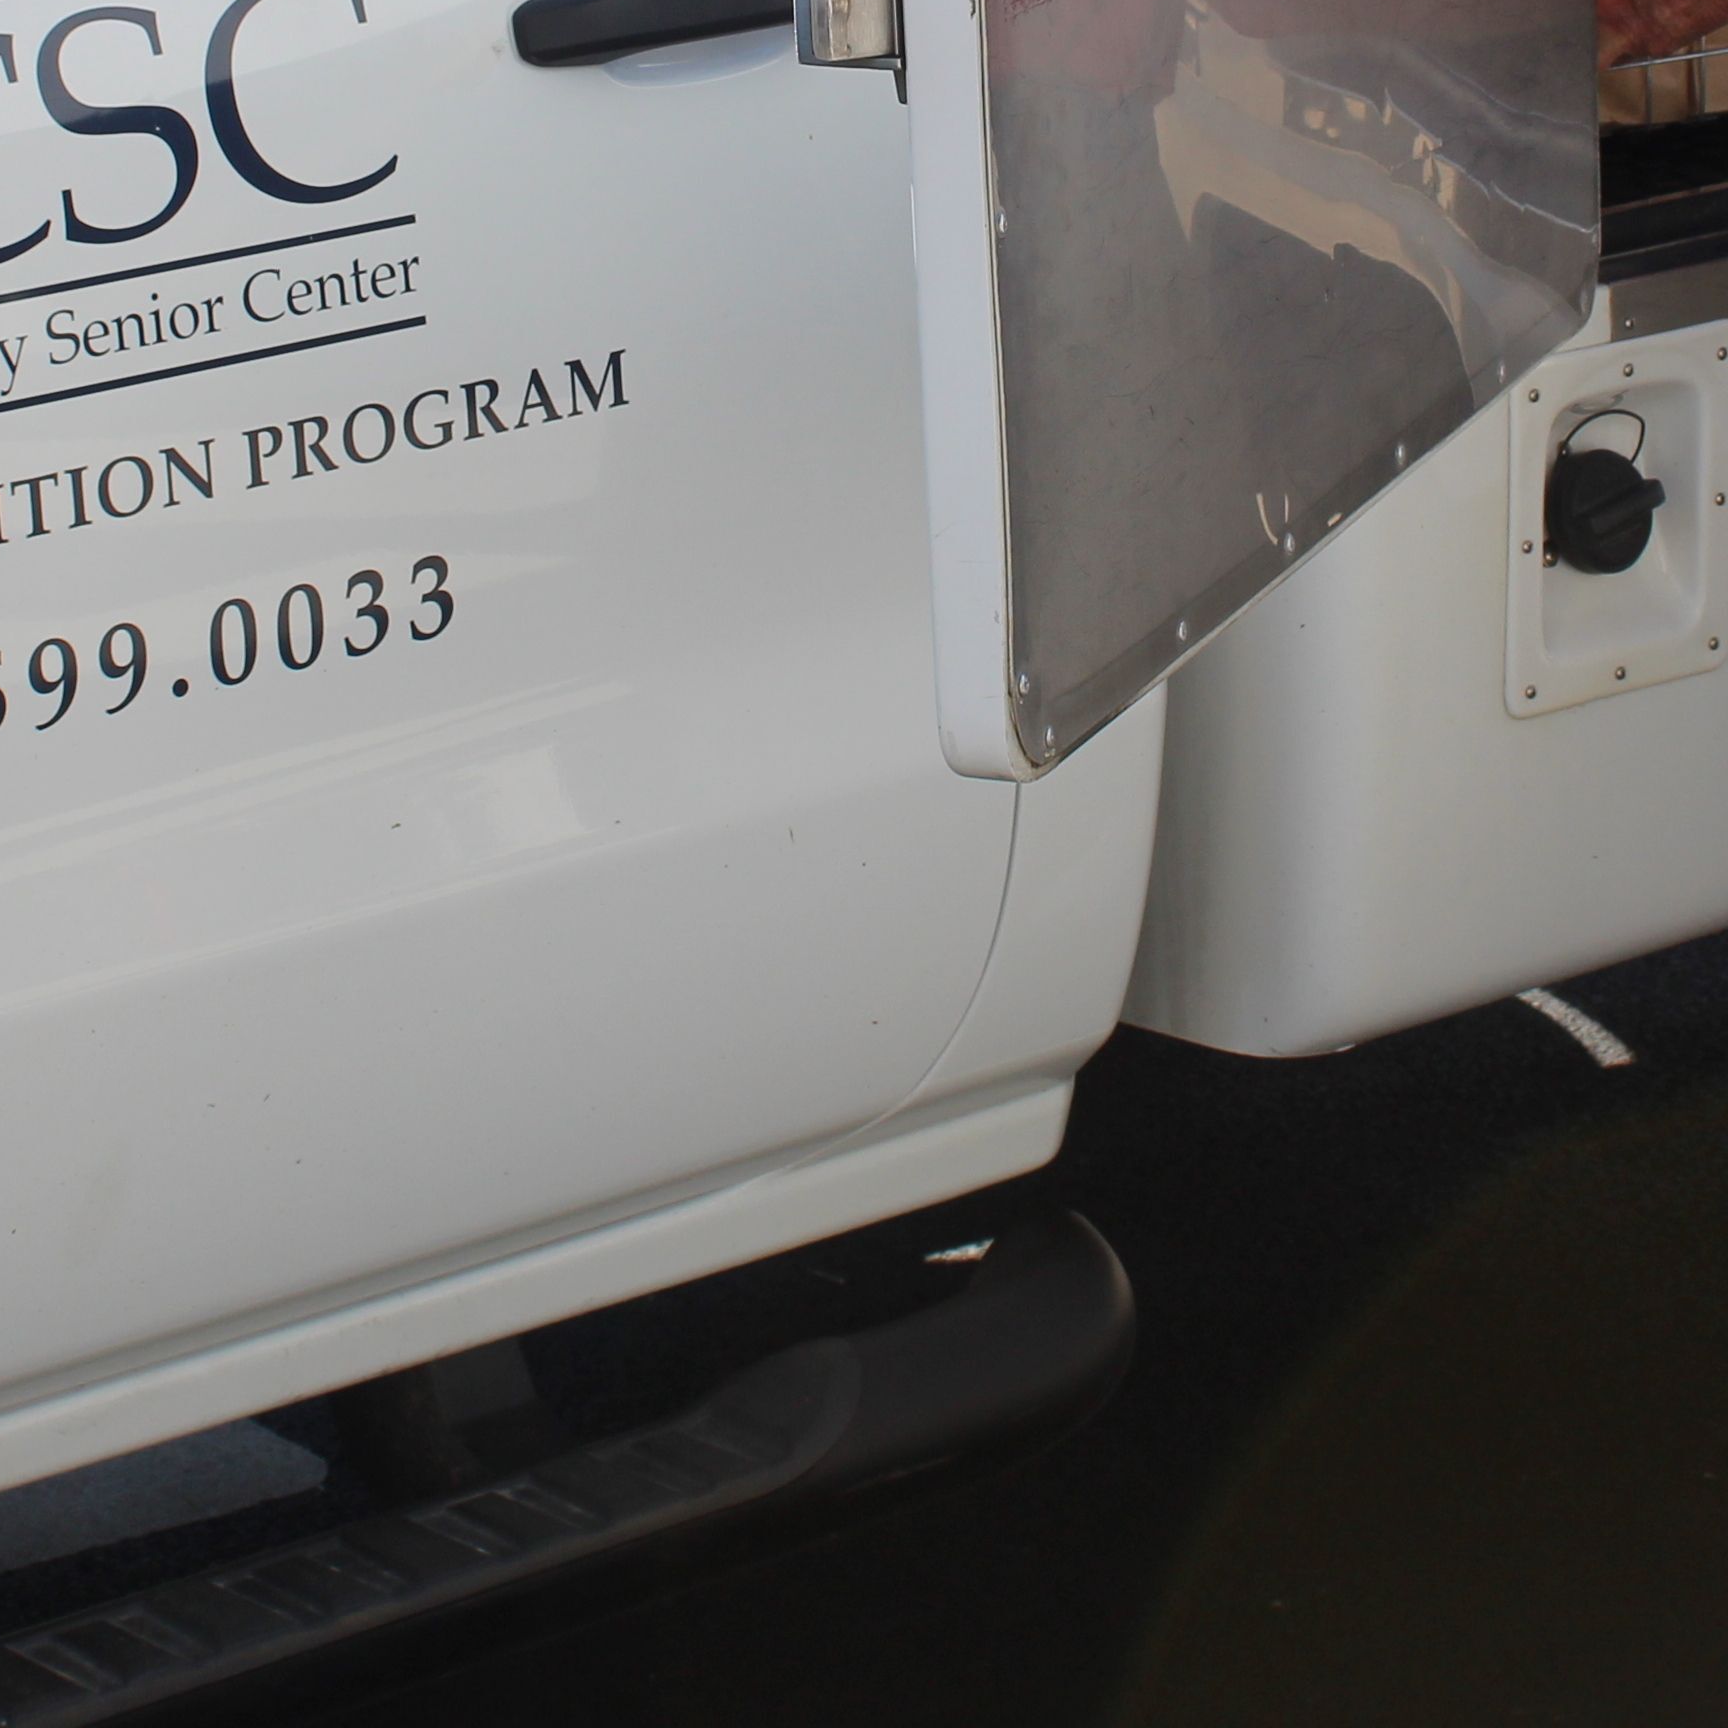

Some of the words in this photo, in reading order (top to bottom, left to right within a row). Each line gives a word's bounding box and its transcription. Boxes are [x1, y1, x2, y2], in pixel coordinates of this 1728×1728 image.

[46, 294, 224, 365] Senior
[242, 256, 420, 323] Center
[241, 348, 630, 490] PROGRAM
